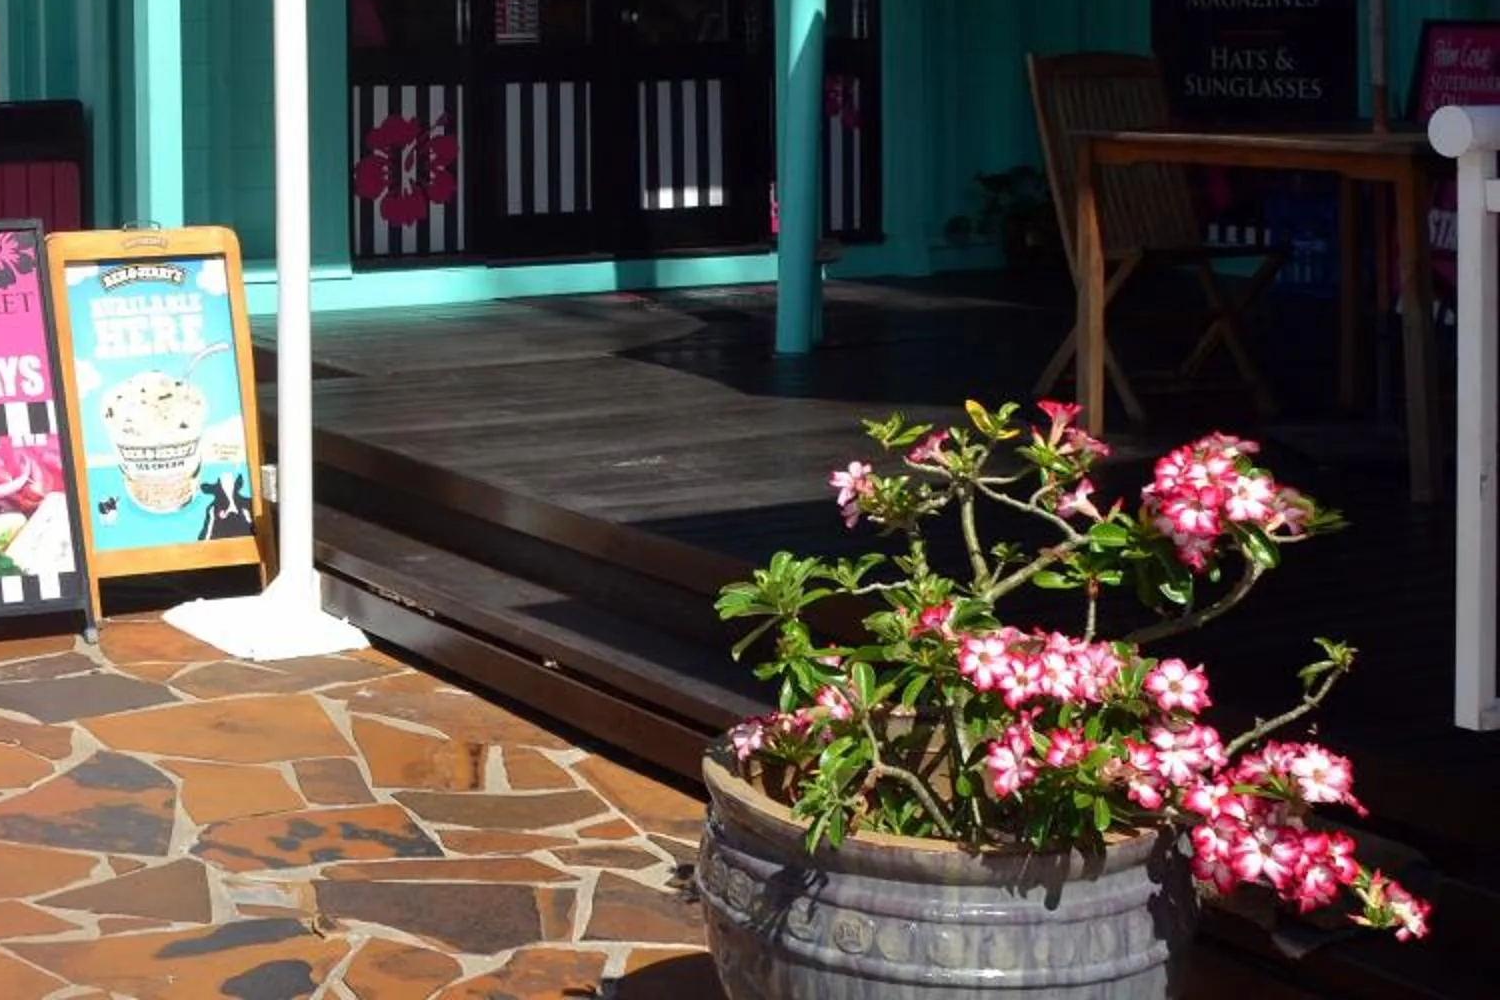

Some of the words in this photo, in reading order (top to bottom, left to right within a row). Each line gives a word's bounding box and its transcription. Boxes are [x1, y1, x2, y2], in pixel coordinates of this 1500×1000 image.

[1210, 46, 1268, 71] HATS
[1274, 46, 1297, 71] &
[1184, 73, 1323, 100] SUNGLASSES
